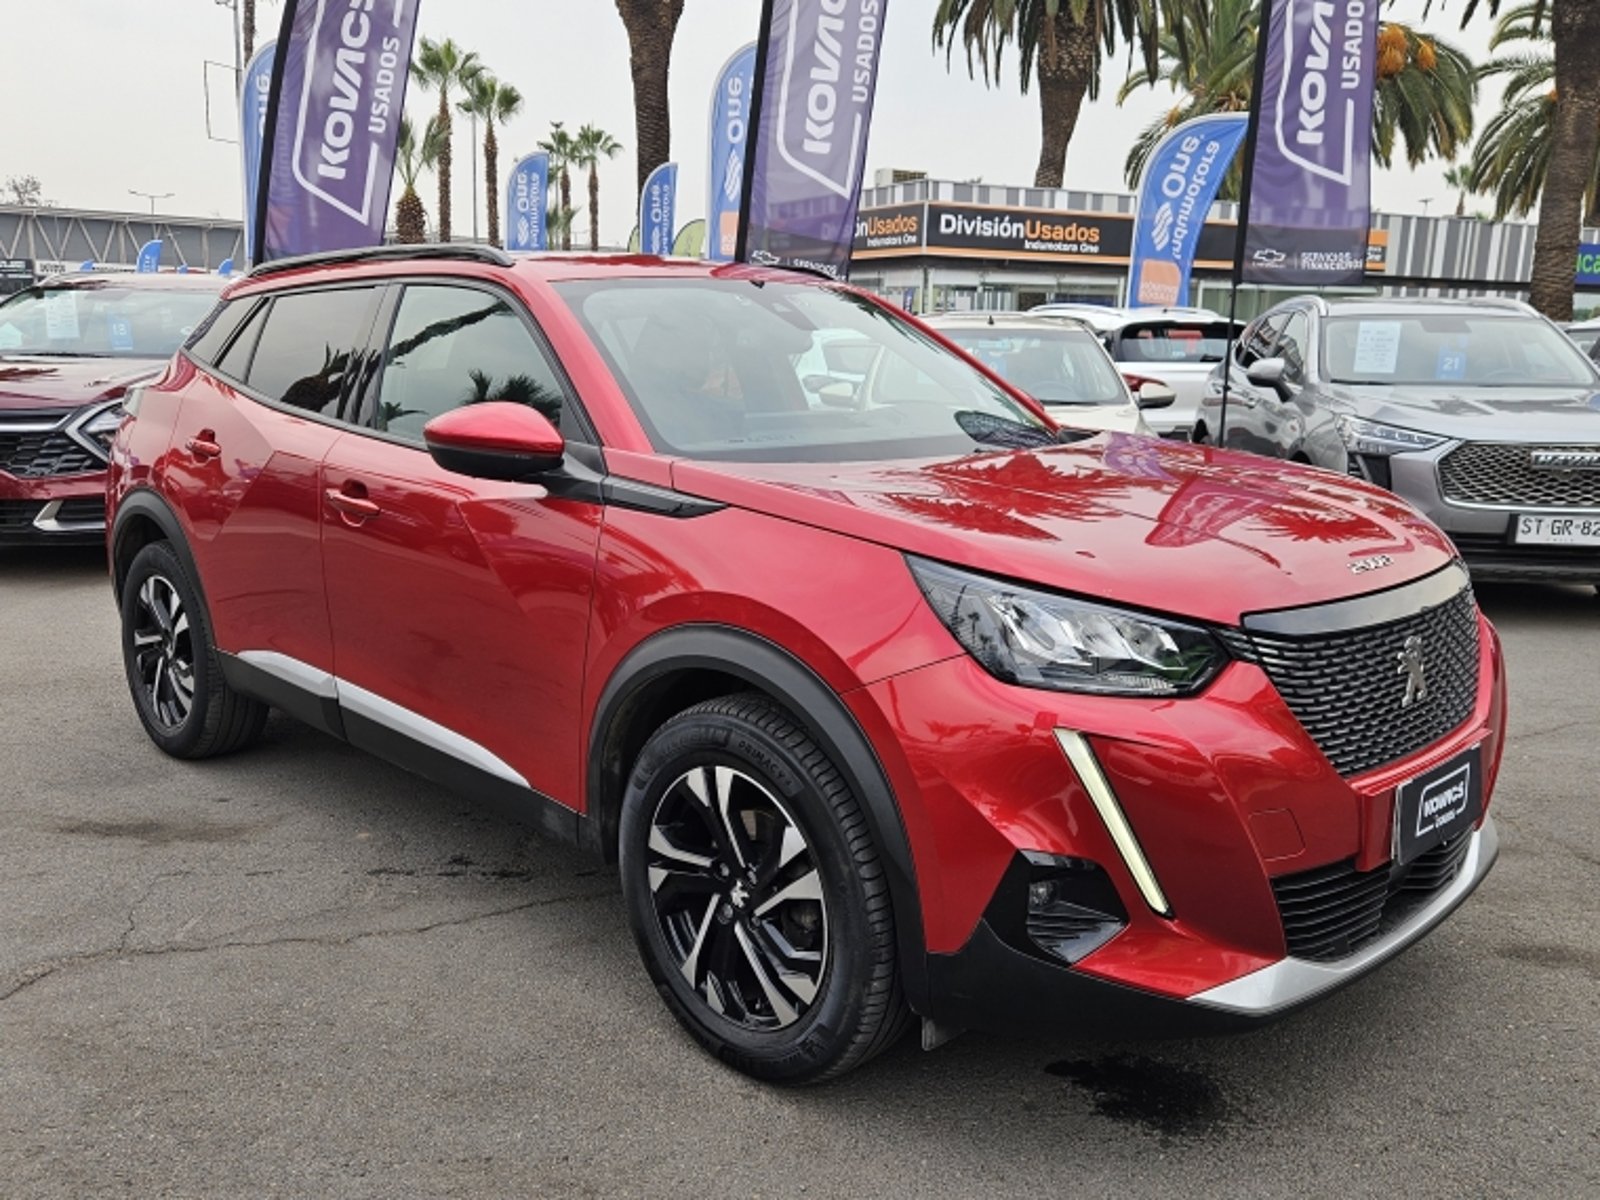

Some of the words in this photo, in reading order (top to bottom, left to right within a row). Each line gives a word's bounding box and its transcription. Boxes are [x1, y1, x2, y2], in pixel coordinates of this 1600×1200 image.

[368, 37, 400, 134] USADOS
[852, 0, 879, 103] USADOS
[1341, 1, 1365, 89] USADO
[1442, 356, 1461, 371] 21
